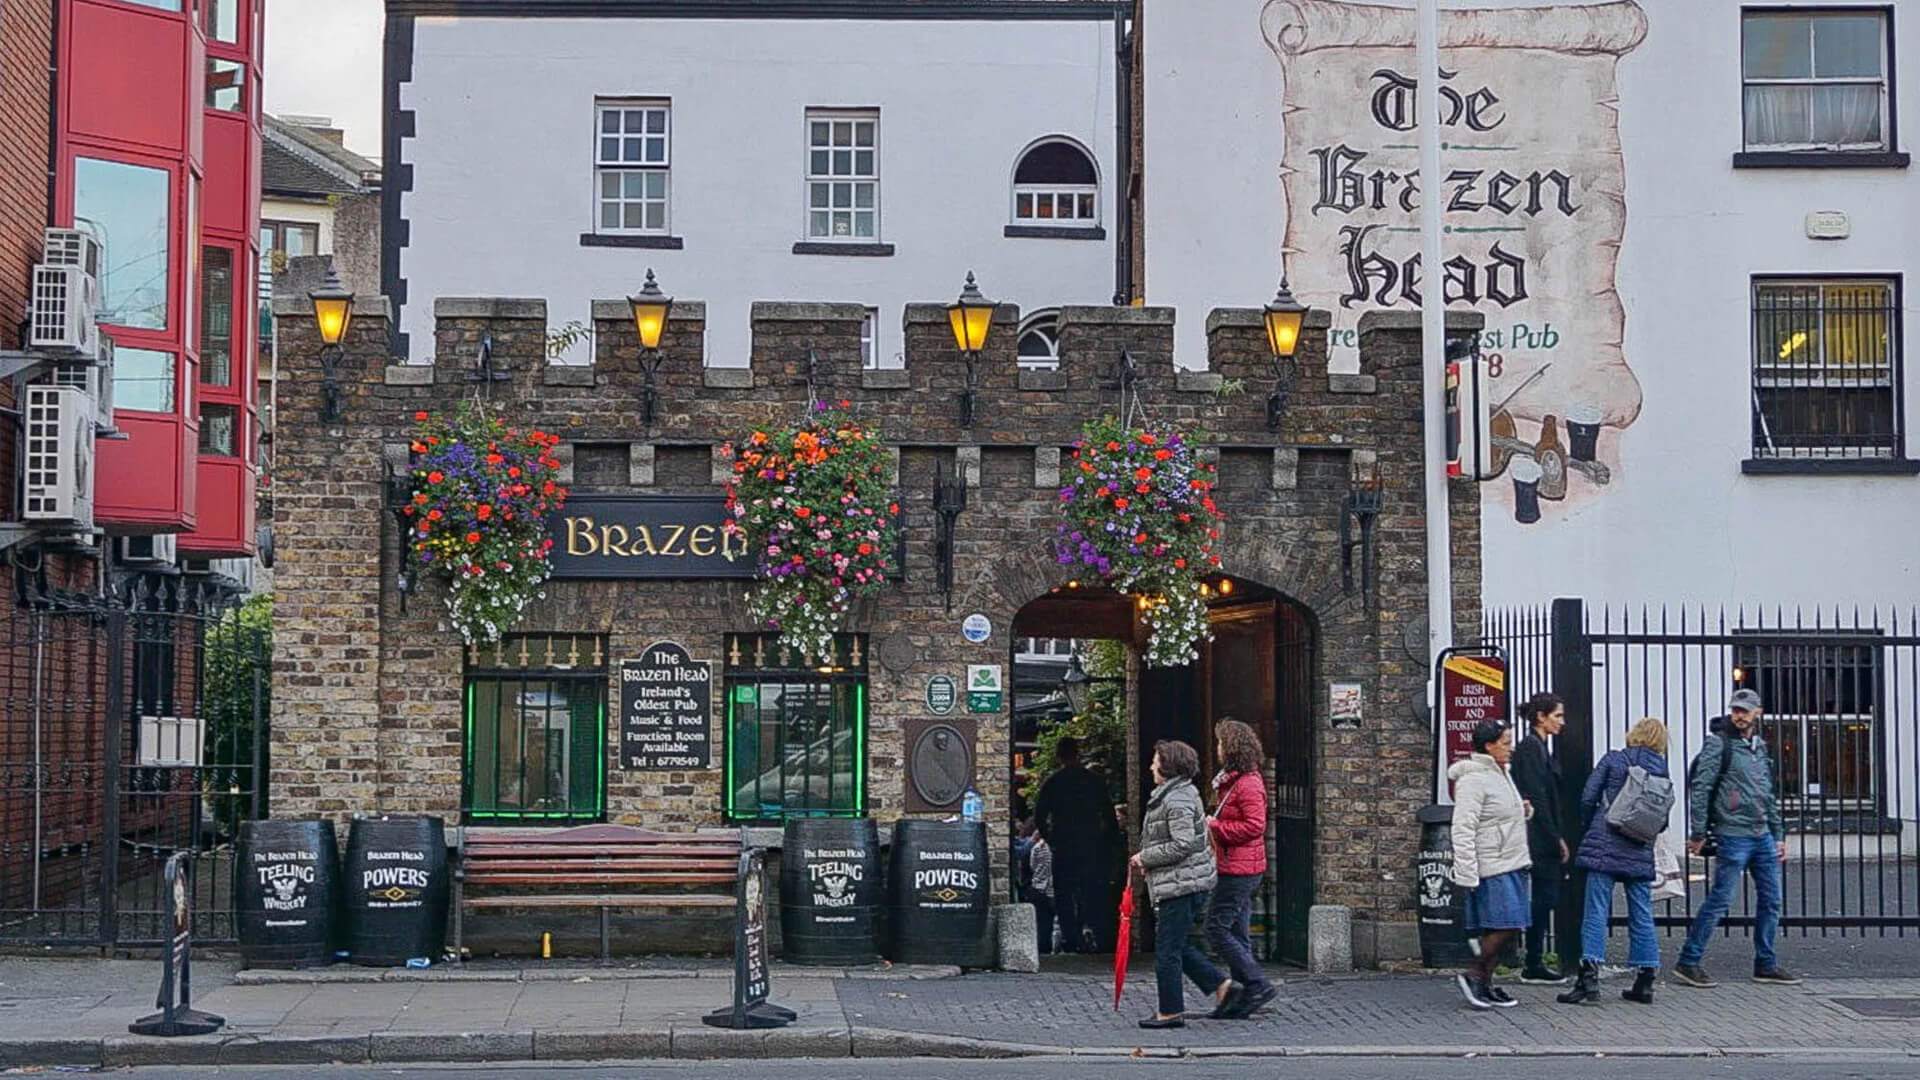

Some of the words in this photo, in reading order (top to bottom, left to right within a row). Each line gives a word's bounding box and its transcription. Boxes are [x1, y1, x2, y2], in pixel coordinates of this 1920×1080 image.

[1370, 66, 1506, 131] The
[1308, 144, 1582, 217] Brazen
[1512, 323, 1559, 350] Pub
[653, 651, 680, 665] The
[641, 686, 691, 698] Ireland's
[1462, 684, 1485, 695] IRISH
[634, 699, 670, 710] Oldest
[674, 699, 698, 710] Pub
[1455, 696, 1495, 707] FOLKLORE
[630, 714, 660, 725] Music
[663, 715, 673, 725] &
[678, 714, 702, 725] Food
[1465, 709, 1485, 719] AND
[626, 731, 672, 741] Function
[675, 731, 705, 741] Room
[642, 742, 689, 752] Available
[631, 756, 646, 767] Tel
[257, 864, 315, 885] TEELING
[363, 867, 430, 889] POWERS
[807, 862, 863, 881] TEELING
[915, 869, 978, 889] POWERS
[263, 895, 307, 910] WHISKEY
